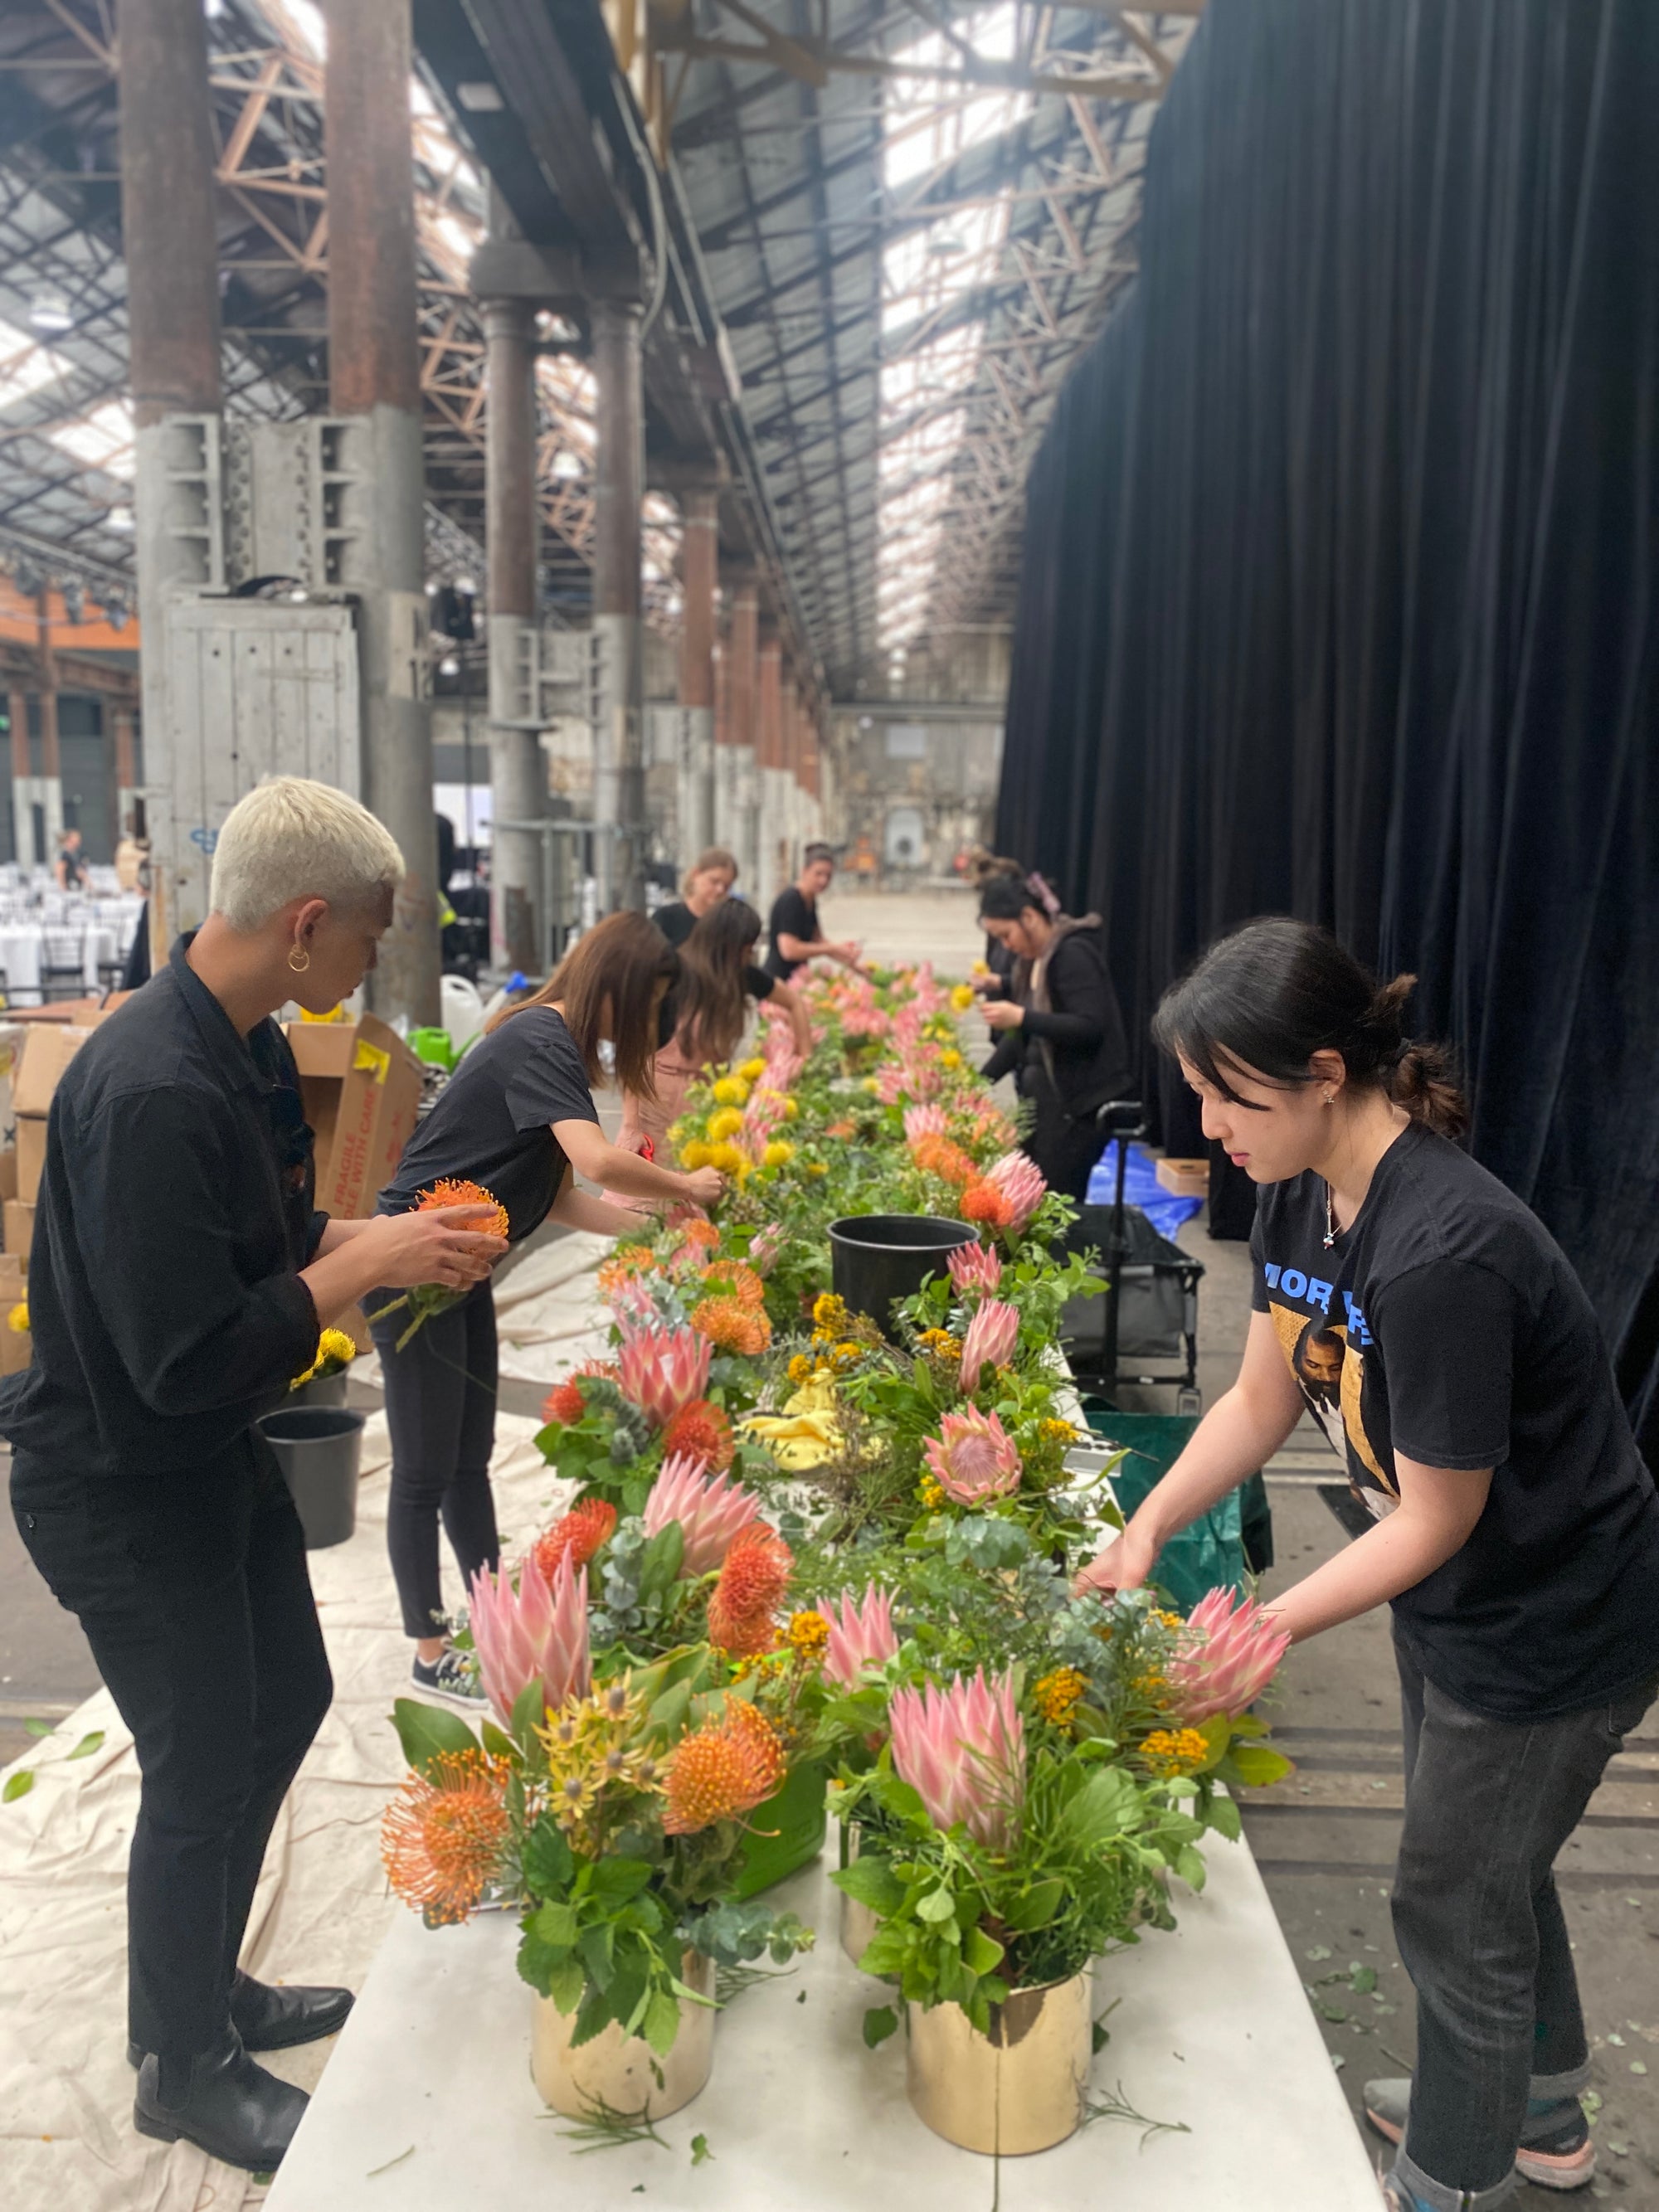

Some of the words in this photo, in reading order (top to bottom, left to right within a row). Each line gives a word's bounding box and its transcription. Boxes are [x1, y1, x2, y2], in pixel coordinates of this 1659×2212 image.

[333, 1132, 355, 1206] FRAGILE
[351, 1137, 367, 1184] WITH
[359, 1088, 375, 1135] CARE
